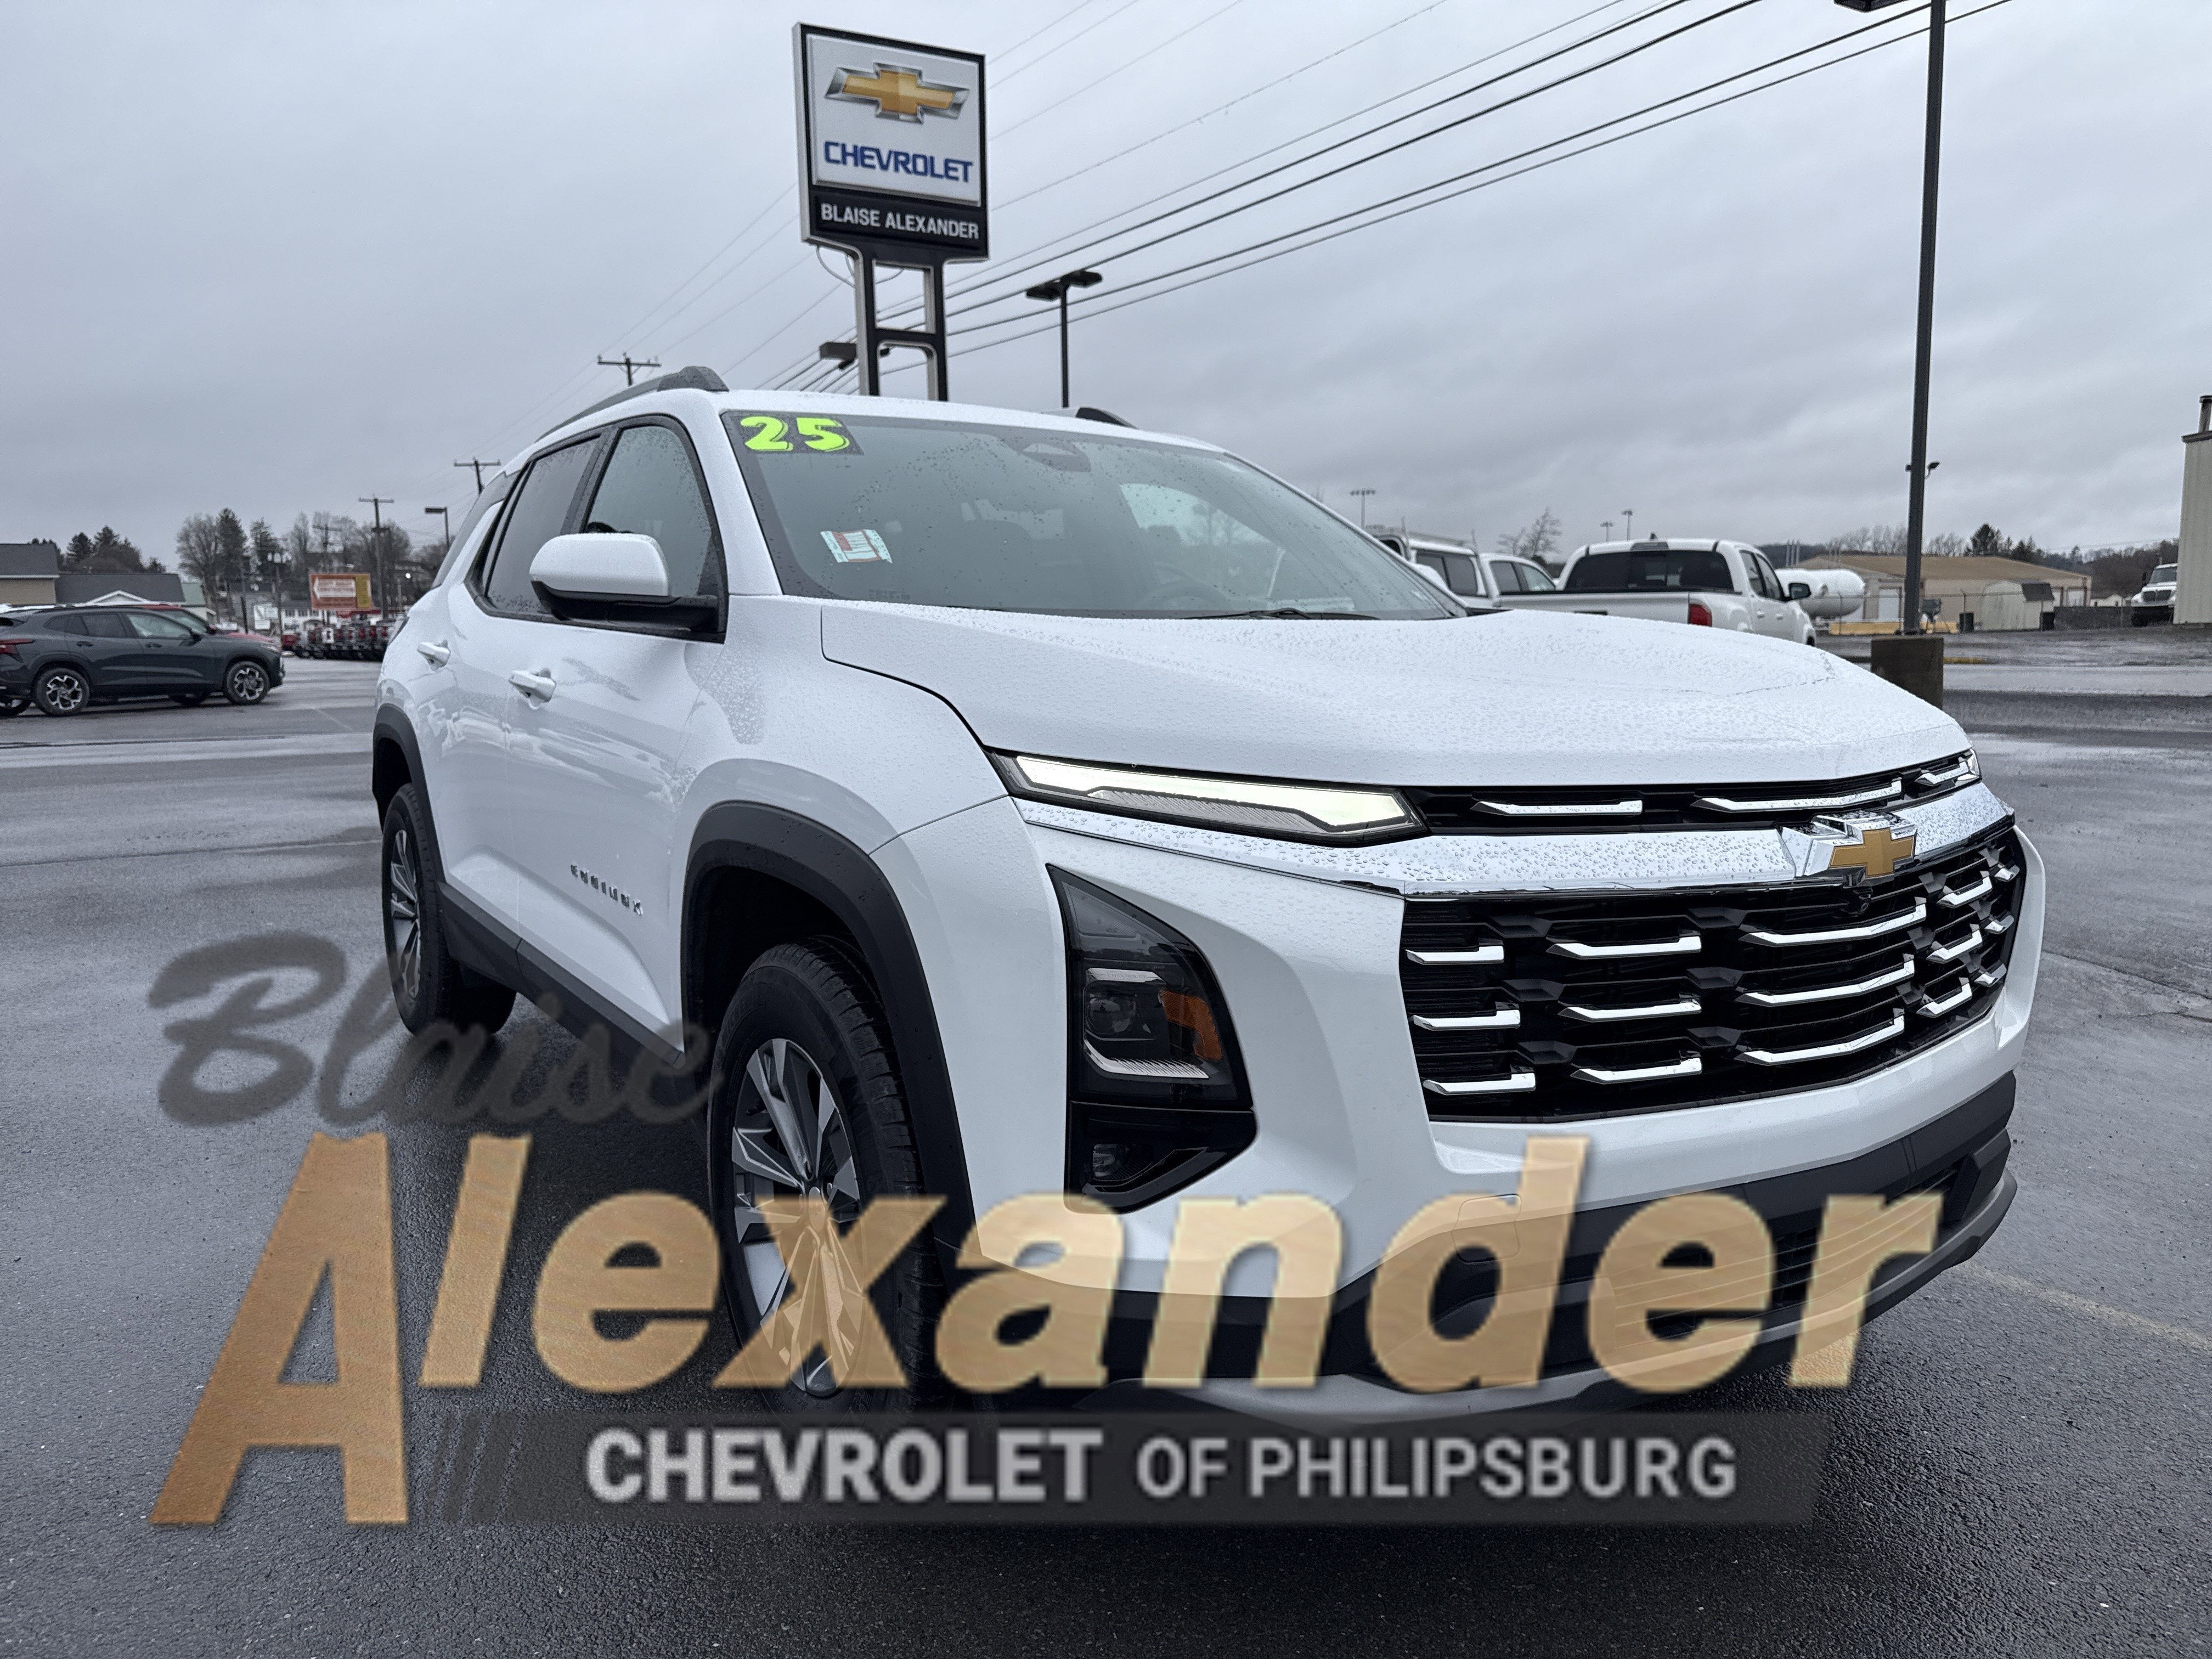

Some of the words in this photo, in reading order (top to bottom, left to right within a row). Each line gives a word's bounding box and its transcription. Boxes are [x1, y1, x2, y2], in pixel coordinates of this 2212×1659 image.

[824, 141, 973, 183] CHEVROLET
[821, 204, 880, 227] BLAISE
[884, 211, 979, 240] ALEXANDER
[740, 416, 850, 452] 25
